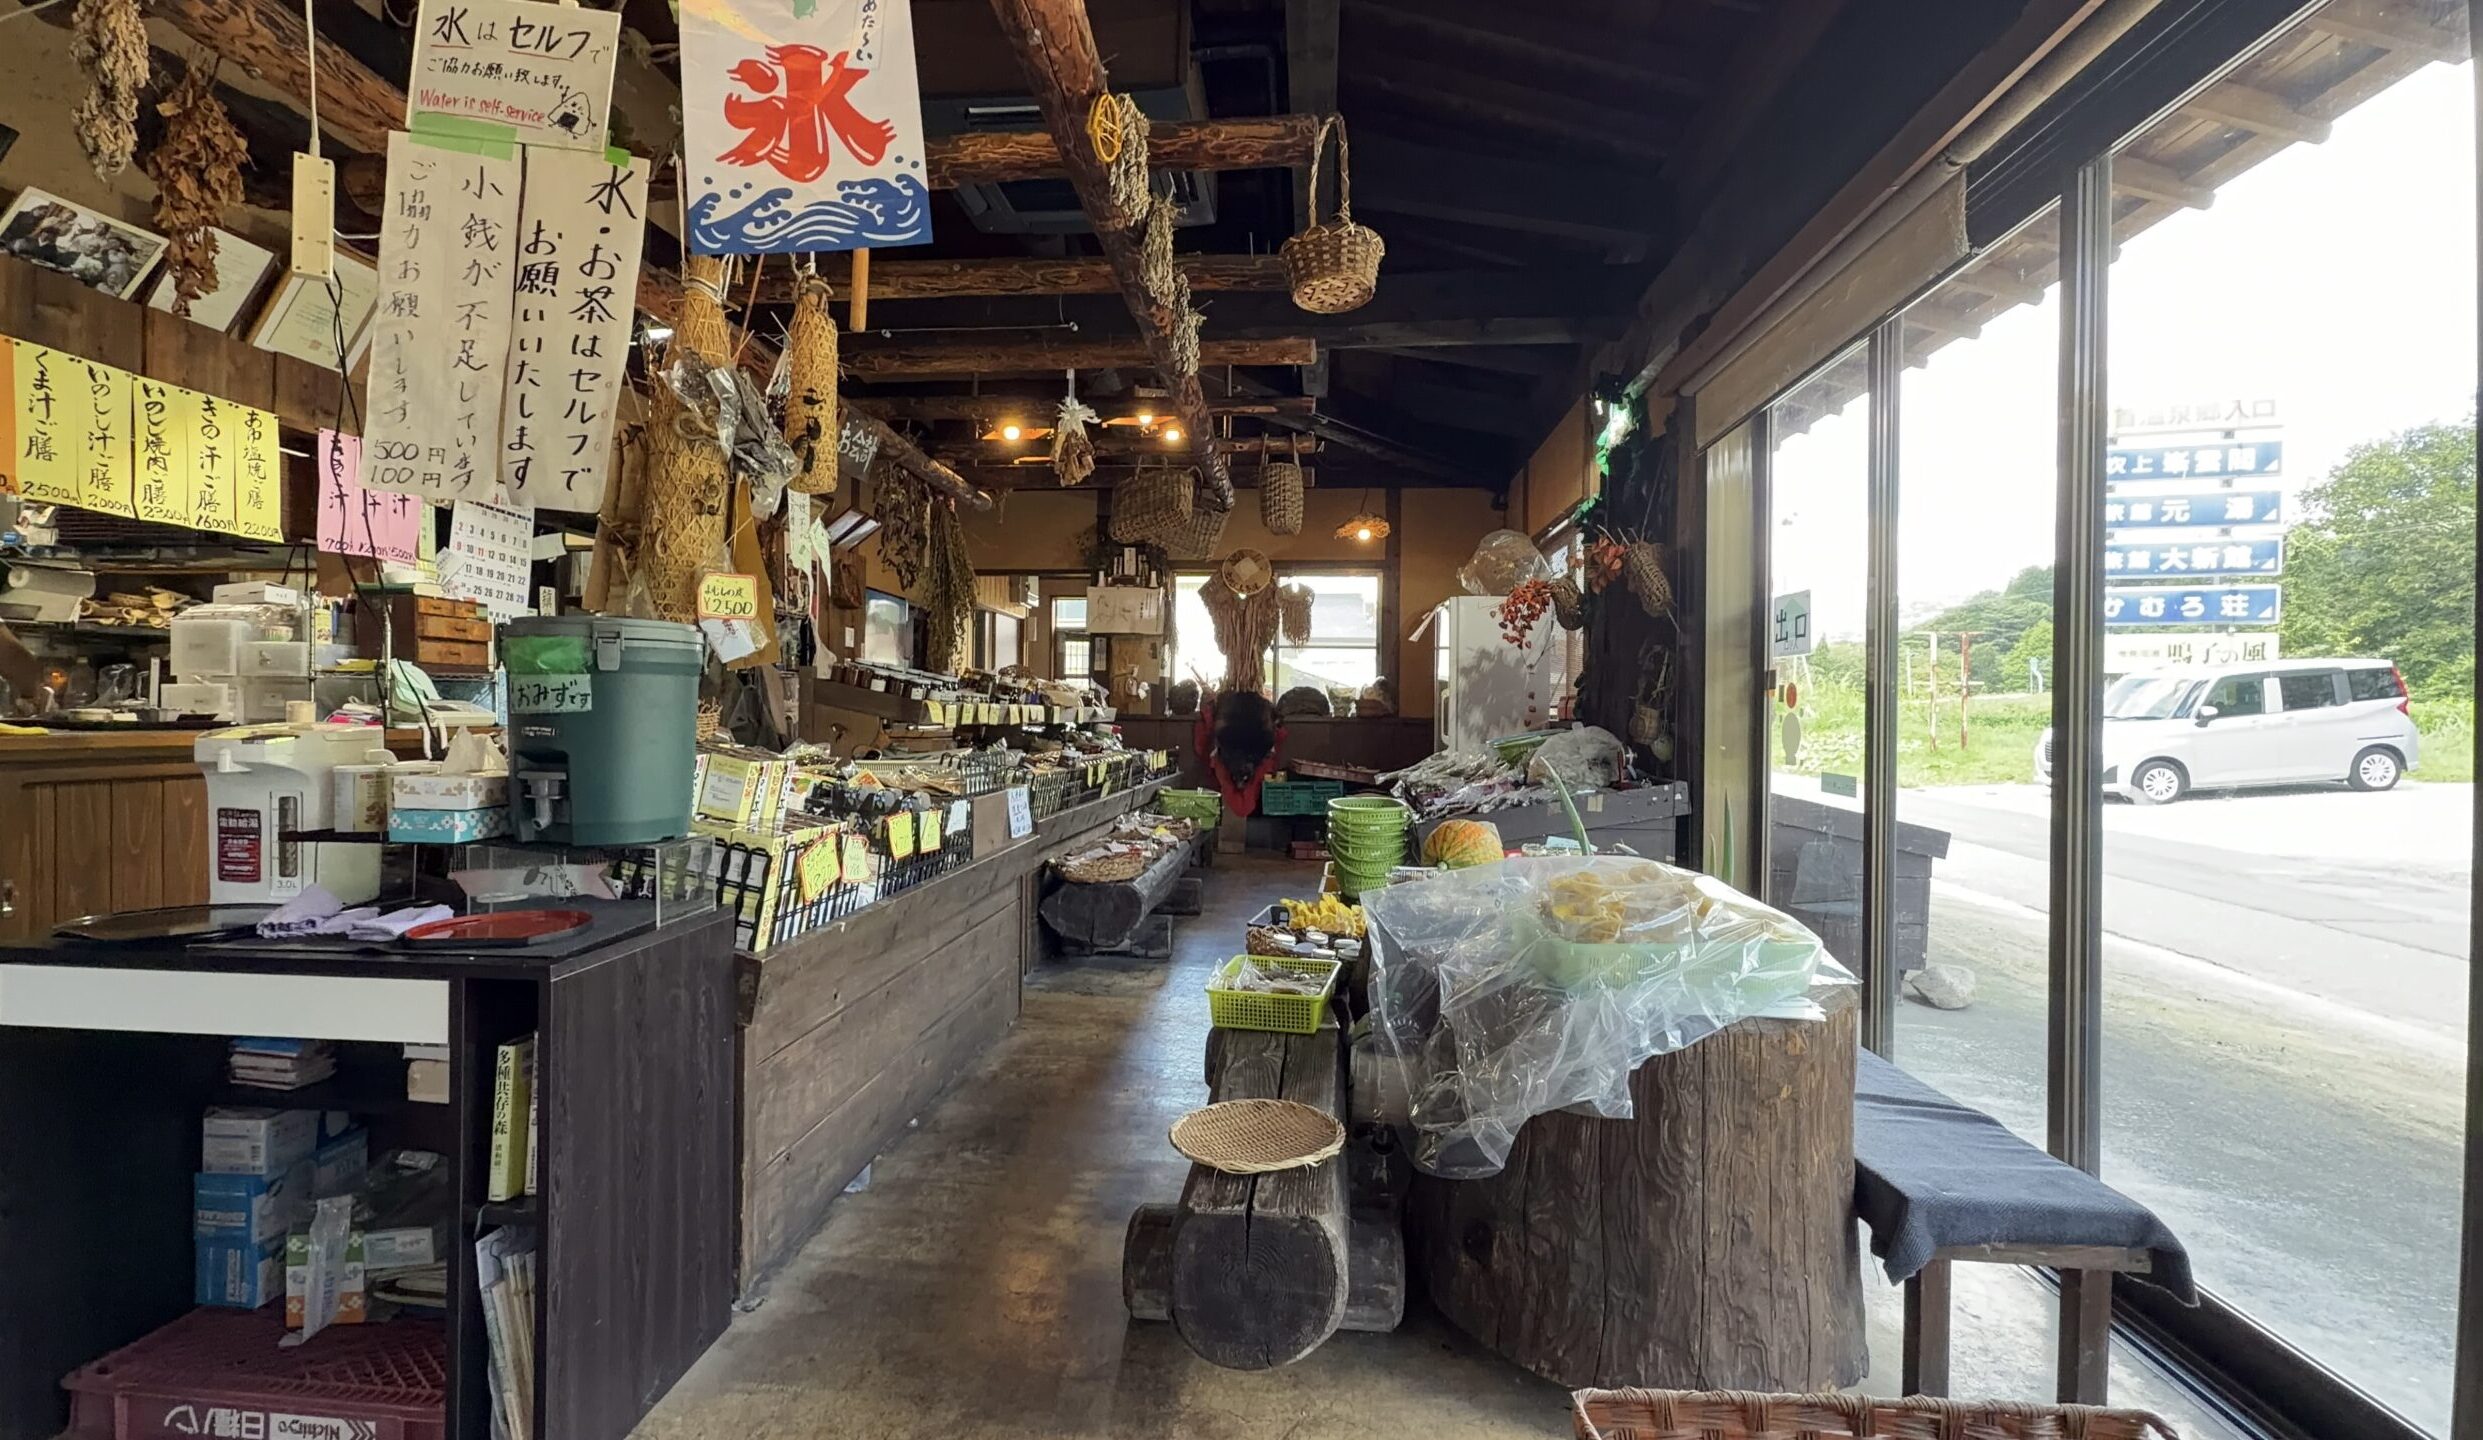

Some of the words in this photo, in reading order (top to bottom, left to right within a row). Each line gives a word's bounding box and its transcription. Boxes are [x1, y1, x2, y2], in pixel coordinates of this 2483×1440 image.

[431, 6, 610, 64] 水はセルフで
[420, 89, 459, 108] Water
[463, 94, 475, 108] is
[479, 100, 545, 123] self-service
[715, 43, 898, 184] 氷
[450, 166, 503, 493] 小銭が不足しています
[507, 219, 563, 490] お願いいたします
[560, 165, 638, 492] 水・お茶はセルフで
[24, 350, 59, 462] くま汁ご膳
[87, 364, 116, 492] いのしし汁ご膳
[142, 382, 171, 505] いのしし焼肉ご膳
[374, 441, 446, 466] 500円
[836, 421, 878, 473] お会計
[22, 481, 81, 505] 2500円
[87, 493, 132, 514] 2000円
[371, 466, 442, 489] 100円
[195, 513, 237, 531] 1600円
[1775, 609, 1807, 643] 出口
[517, 679, 591, 709] おみずです
[493, 1049, 511, 1135] 多種共存の森
